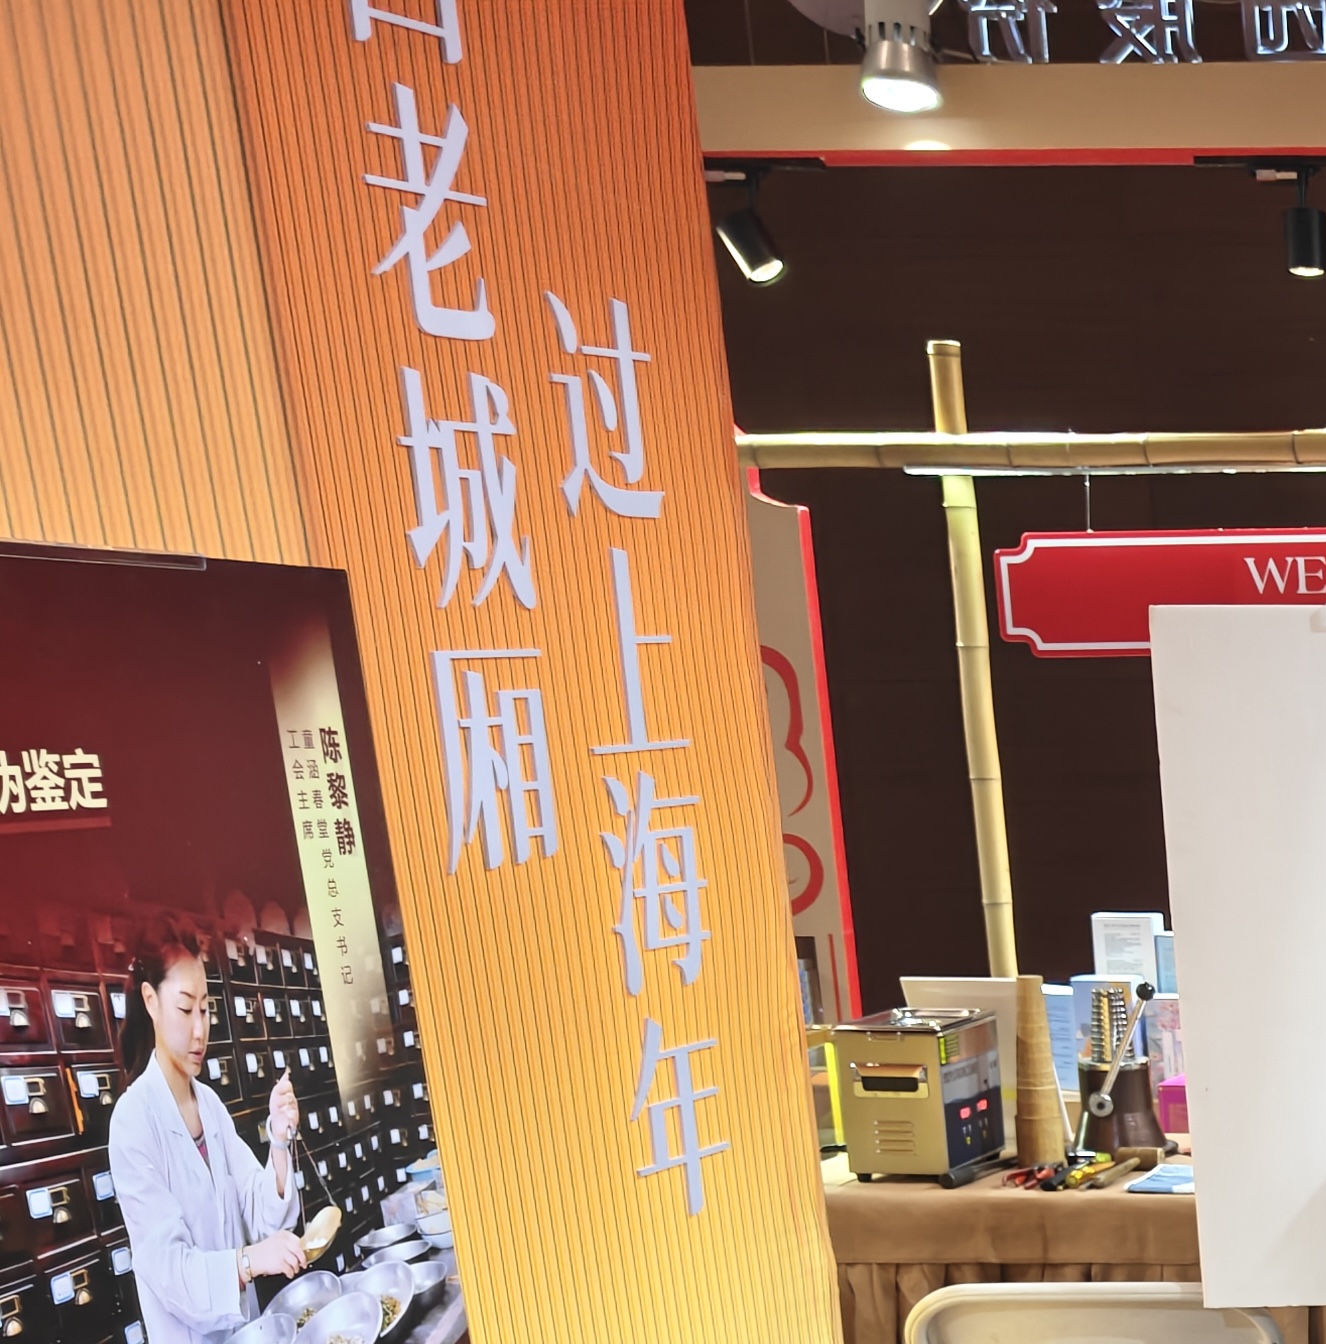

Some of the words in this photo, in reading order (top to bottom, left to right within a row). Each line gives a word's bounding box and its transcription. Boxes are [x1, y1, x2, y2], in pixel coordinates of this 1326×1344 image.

[286, 729, 315, 841] 工会主席
[319, 727, 356, 855] 陈黎静
[546, 290, 731, 1217] 过上海年
